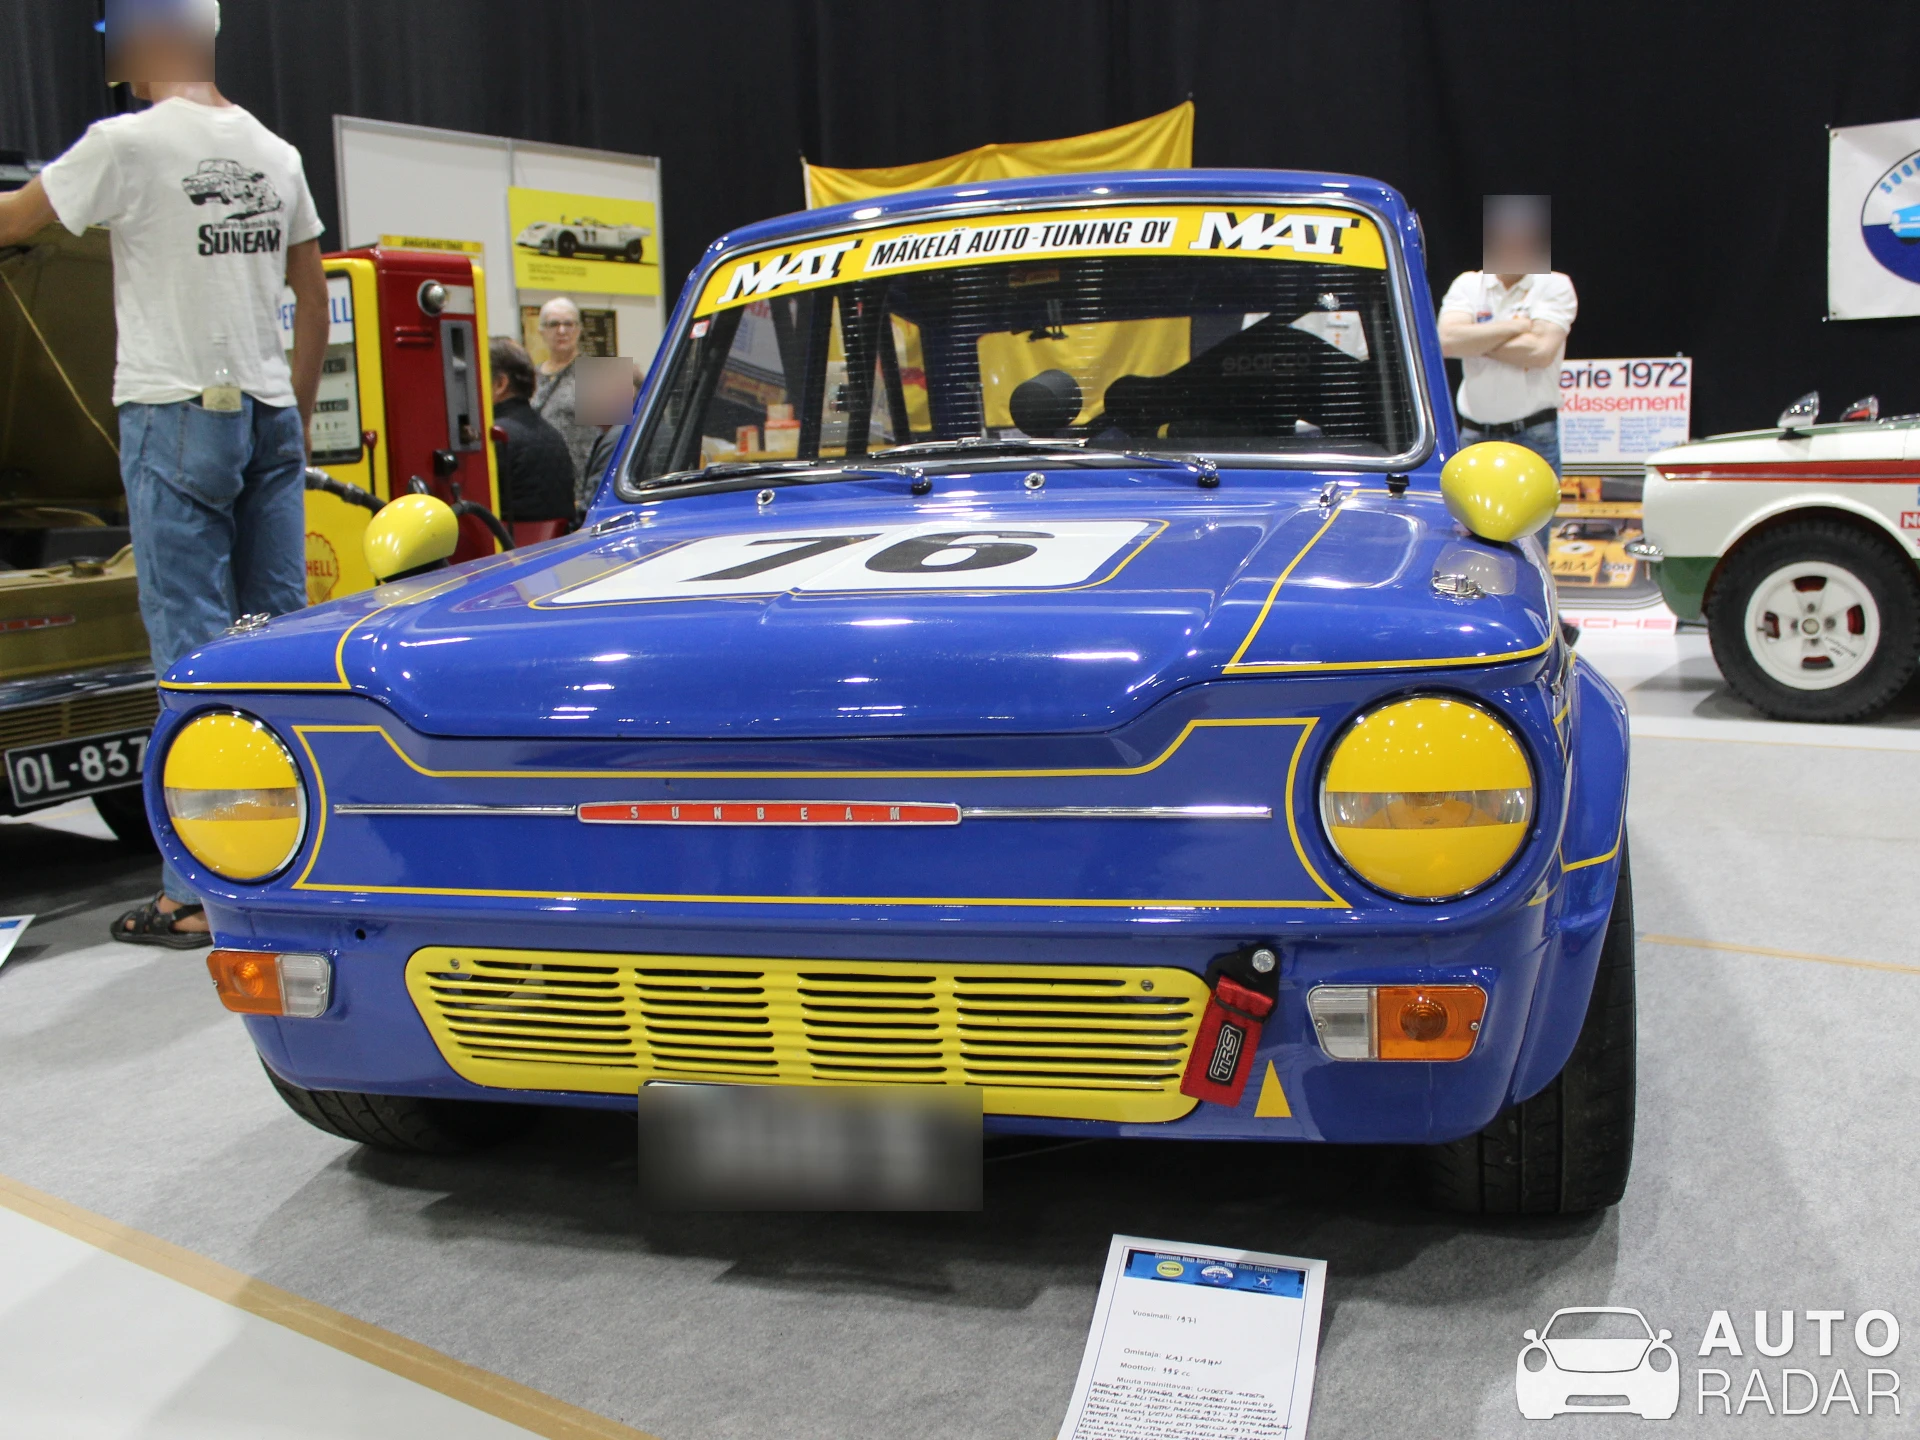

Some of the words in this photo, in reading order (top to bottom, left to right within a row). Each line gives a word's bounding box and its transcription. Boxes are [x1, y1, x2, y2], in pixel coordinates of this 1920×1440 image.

[871, 227, 966, 267] MÄKELÄ
[1148, 220, 1171, 244] OY
[1188, 211, 1360, 254] MAT
[715, 238, 863, 304] MAT
[1619, 361, 1687, 389] 1972
[678, 530, 1055, 583] 76
[630, 805, 901, 821] SUNBEAM
[1212, 1028, 1238, 1078] TRS
[1132, 1309, 1172, 1321] Vuosimalli:
[1176, 1315, 1198, 1325] 1971
[1120, 1362, 1157, 1373] Moottori:
[1123, 1347, 1162, 1359] Omistaja:
[1165, 1353, 1184, 1363] KAJ
[1116, 1377, 1142, 1386] Muuta
[1143, 1380, 1193, 1391] mainittavaa:
